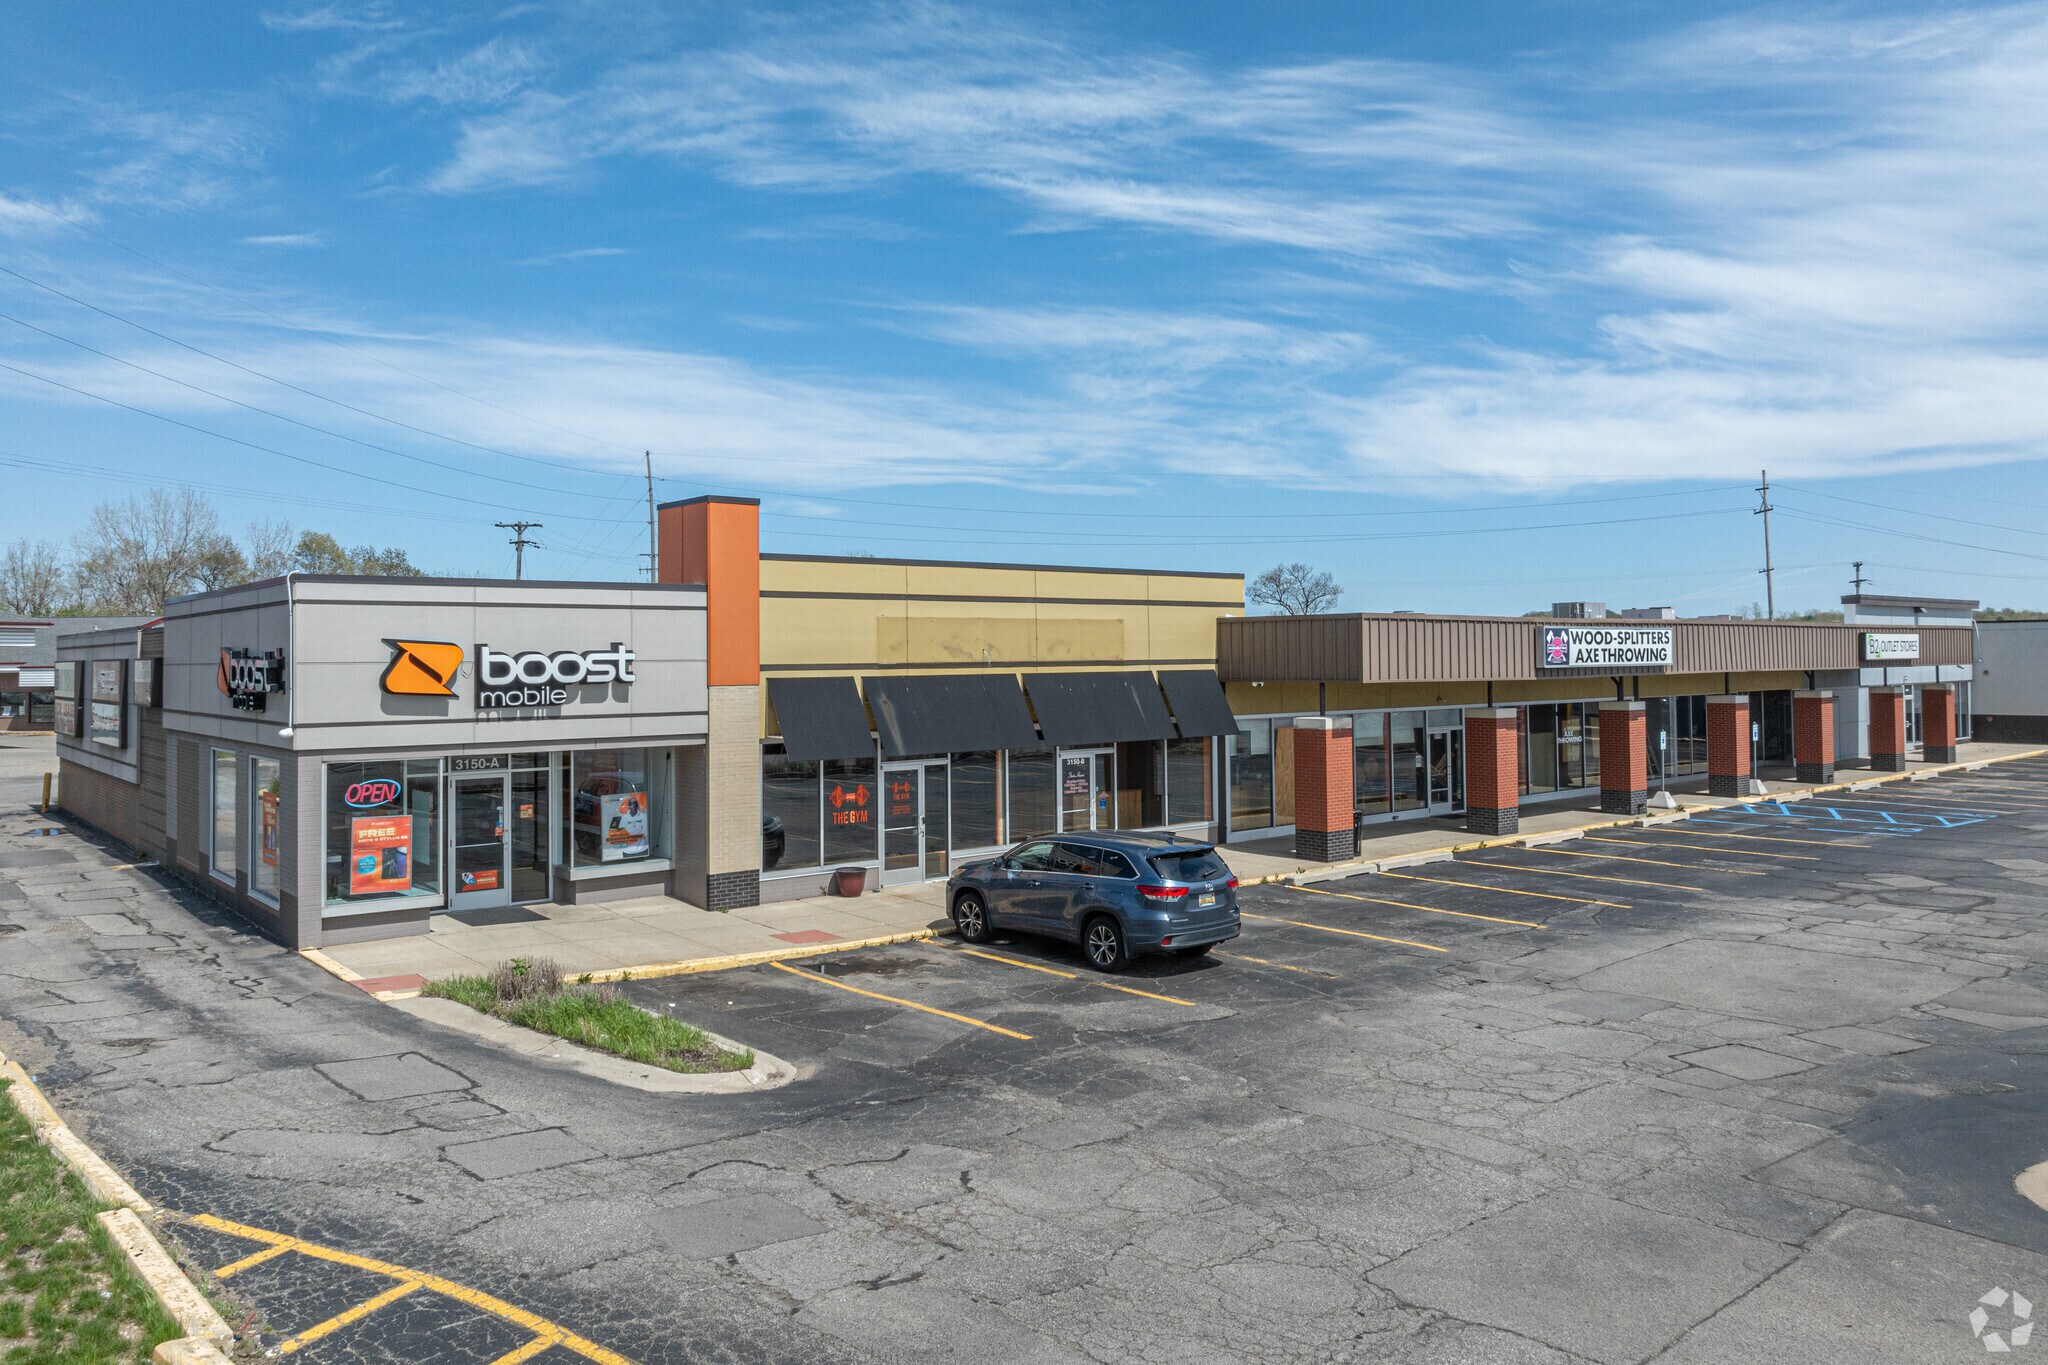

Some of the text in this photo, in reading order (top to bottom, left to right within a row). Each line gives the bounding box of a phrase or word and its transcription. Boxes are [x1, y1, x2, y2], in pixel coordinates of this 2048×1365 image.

[1570, 630, 1670, 645] WOOD-SPLITTERS
[1880, 641, 1899, 652] OUTLET
[1900, 640, 1918, 652] STORES
[1575, 647, 1667, 663] AXE THROWING
[481, 645, 636, 686] boost
[480, 686, 567, 707] mobile
[455, 758, 500, 770] 3150-A
[346, 784, 396, 802] OPEN
[832, 810, 868, 824] THE GYM
[358, 827, 396, 839] FREE
